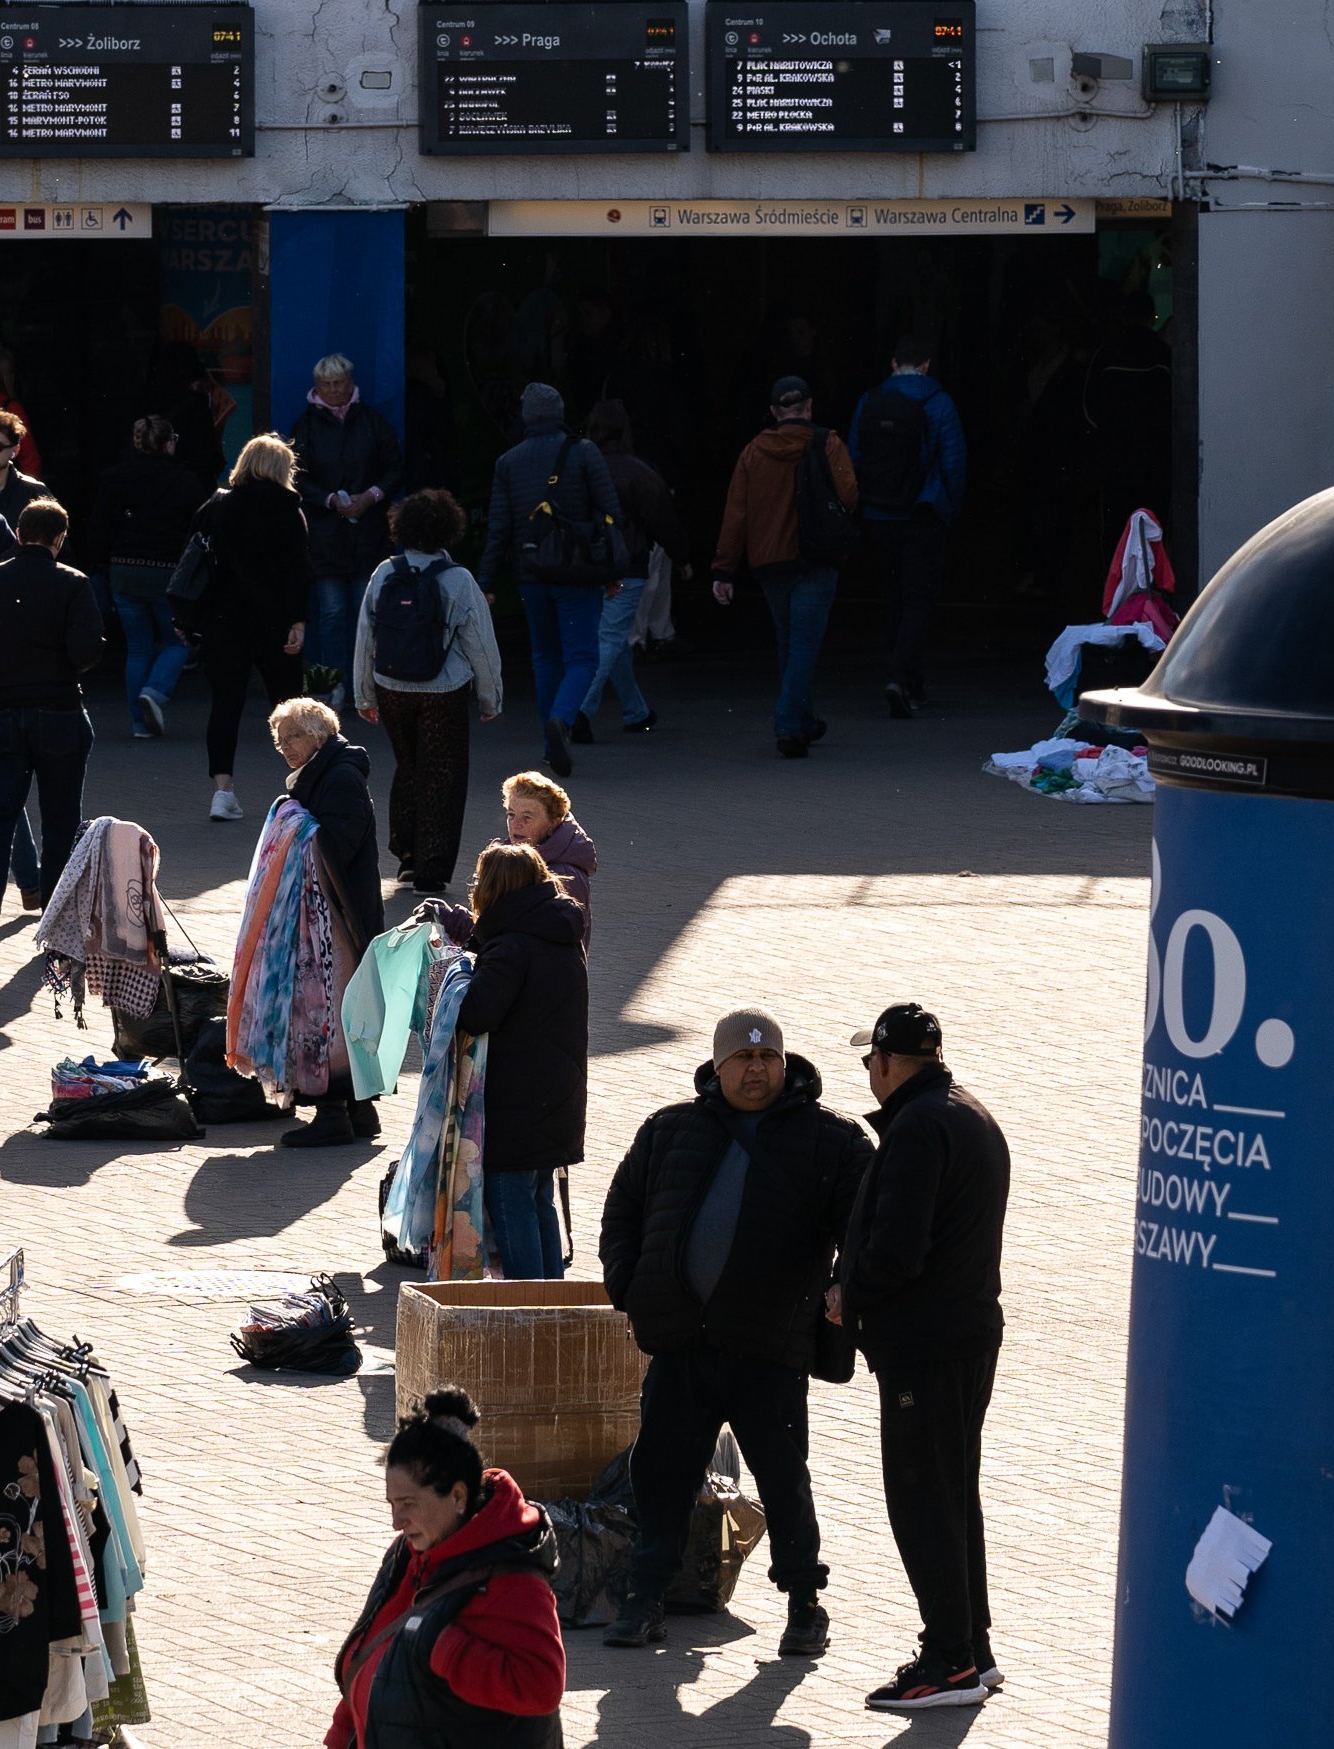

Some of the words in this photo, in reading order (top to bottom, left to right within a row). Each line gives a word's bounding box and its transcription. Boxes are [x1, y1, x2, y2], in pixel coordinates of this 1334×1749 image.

[87, 34, 140, 50] Żoliborz
[523, 34, 560, 49] Praga
[811, 32, 857, 46] Ochota
[779, 74, 835, 82] KRAKOWSKA
[747, 110, 777, 120] METRO
[779, 123, 835, 132] KRAKOWSKA
[28, 213, 43, 225] bus
[677, 208, 752, 226] Warszawa
[755, 204, 840, 226] Śródmieście
[874, 206, 947, 225] Warszawa
[951, 205, 1019, 224] Centralna
[1179, 755, 1258, 776] GOODLOOKING.PL
[1145, 836, 1295, 1068] 0.
[1144, 1063, 1207, 1109] ZNICA
